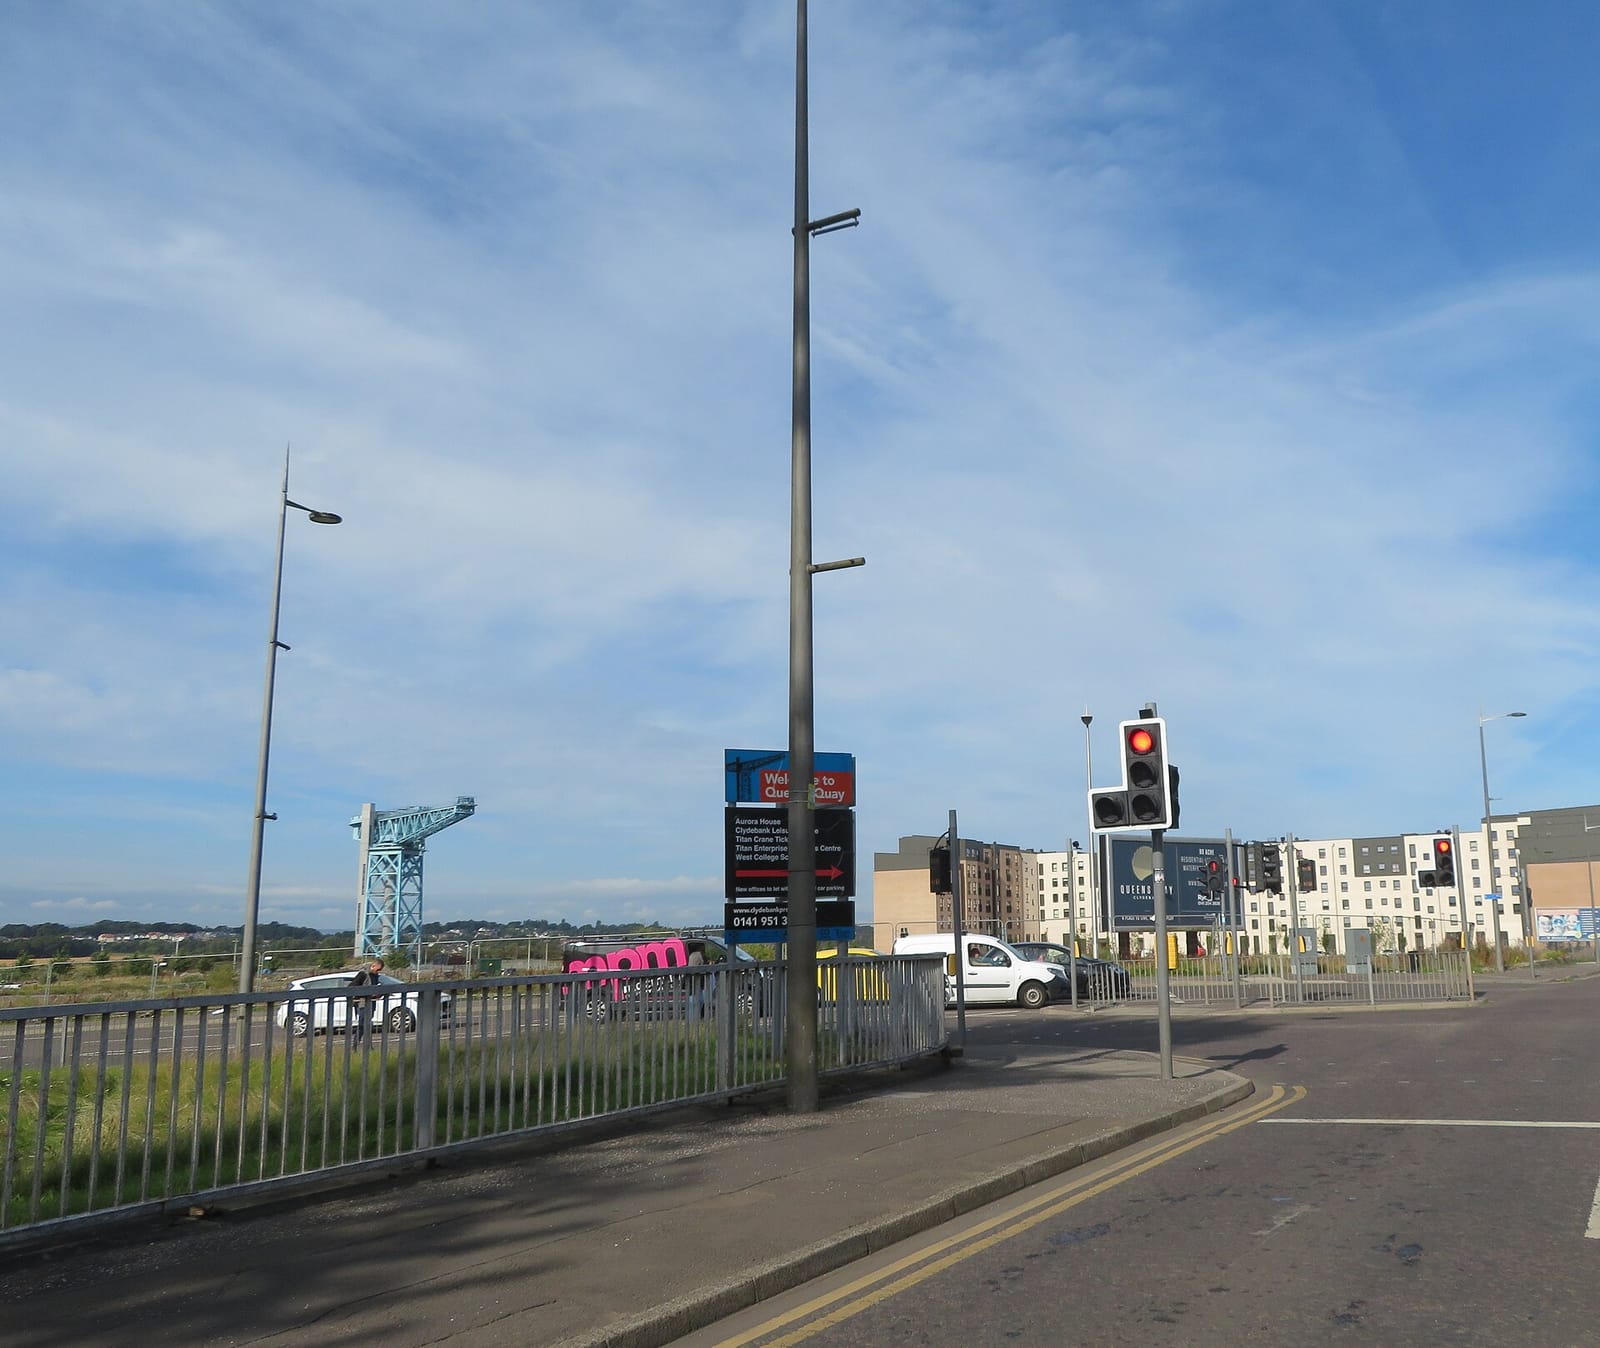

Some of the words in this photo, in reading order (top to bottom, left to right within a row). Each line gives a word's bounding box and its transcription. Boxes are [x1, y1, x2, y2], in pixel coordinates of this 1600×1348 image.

[822, 775, 835, 786] to
[765, 786, 790, 799] Que
[814, 787, 845, 802] Quay
[735, 826, 771, 835] Clydebank
[772, 826, 789, 834] Leisu
[735, 835, 753, 843] Titan
[753, 835, 774, 843] Crane
[775, 835, 789, 843] Tick
[735, 844, 753, 852] Titan
[753, 844, 788, 853] Enterprise
[820, 844, 842, 852] Centre
[735, 853, 753, 861] West
[753, 853, 779, 862] College
[1120, 884, 1152, 895] QUEENS
[733, 917, 757, 927] 0141
[760, 916, 778, 926] 951
